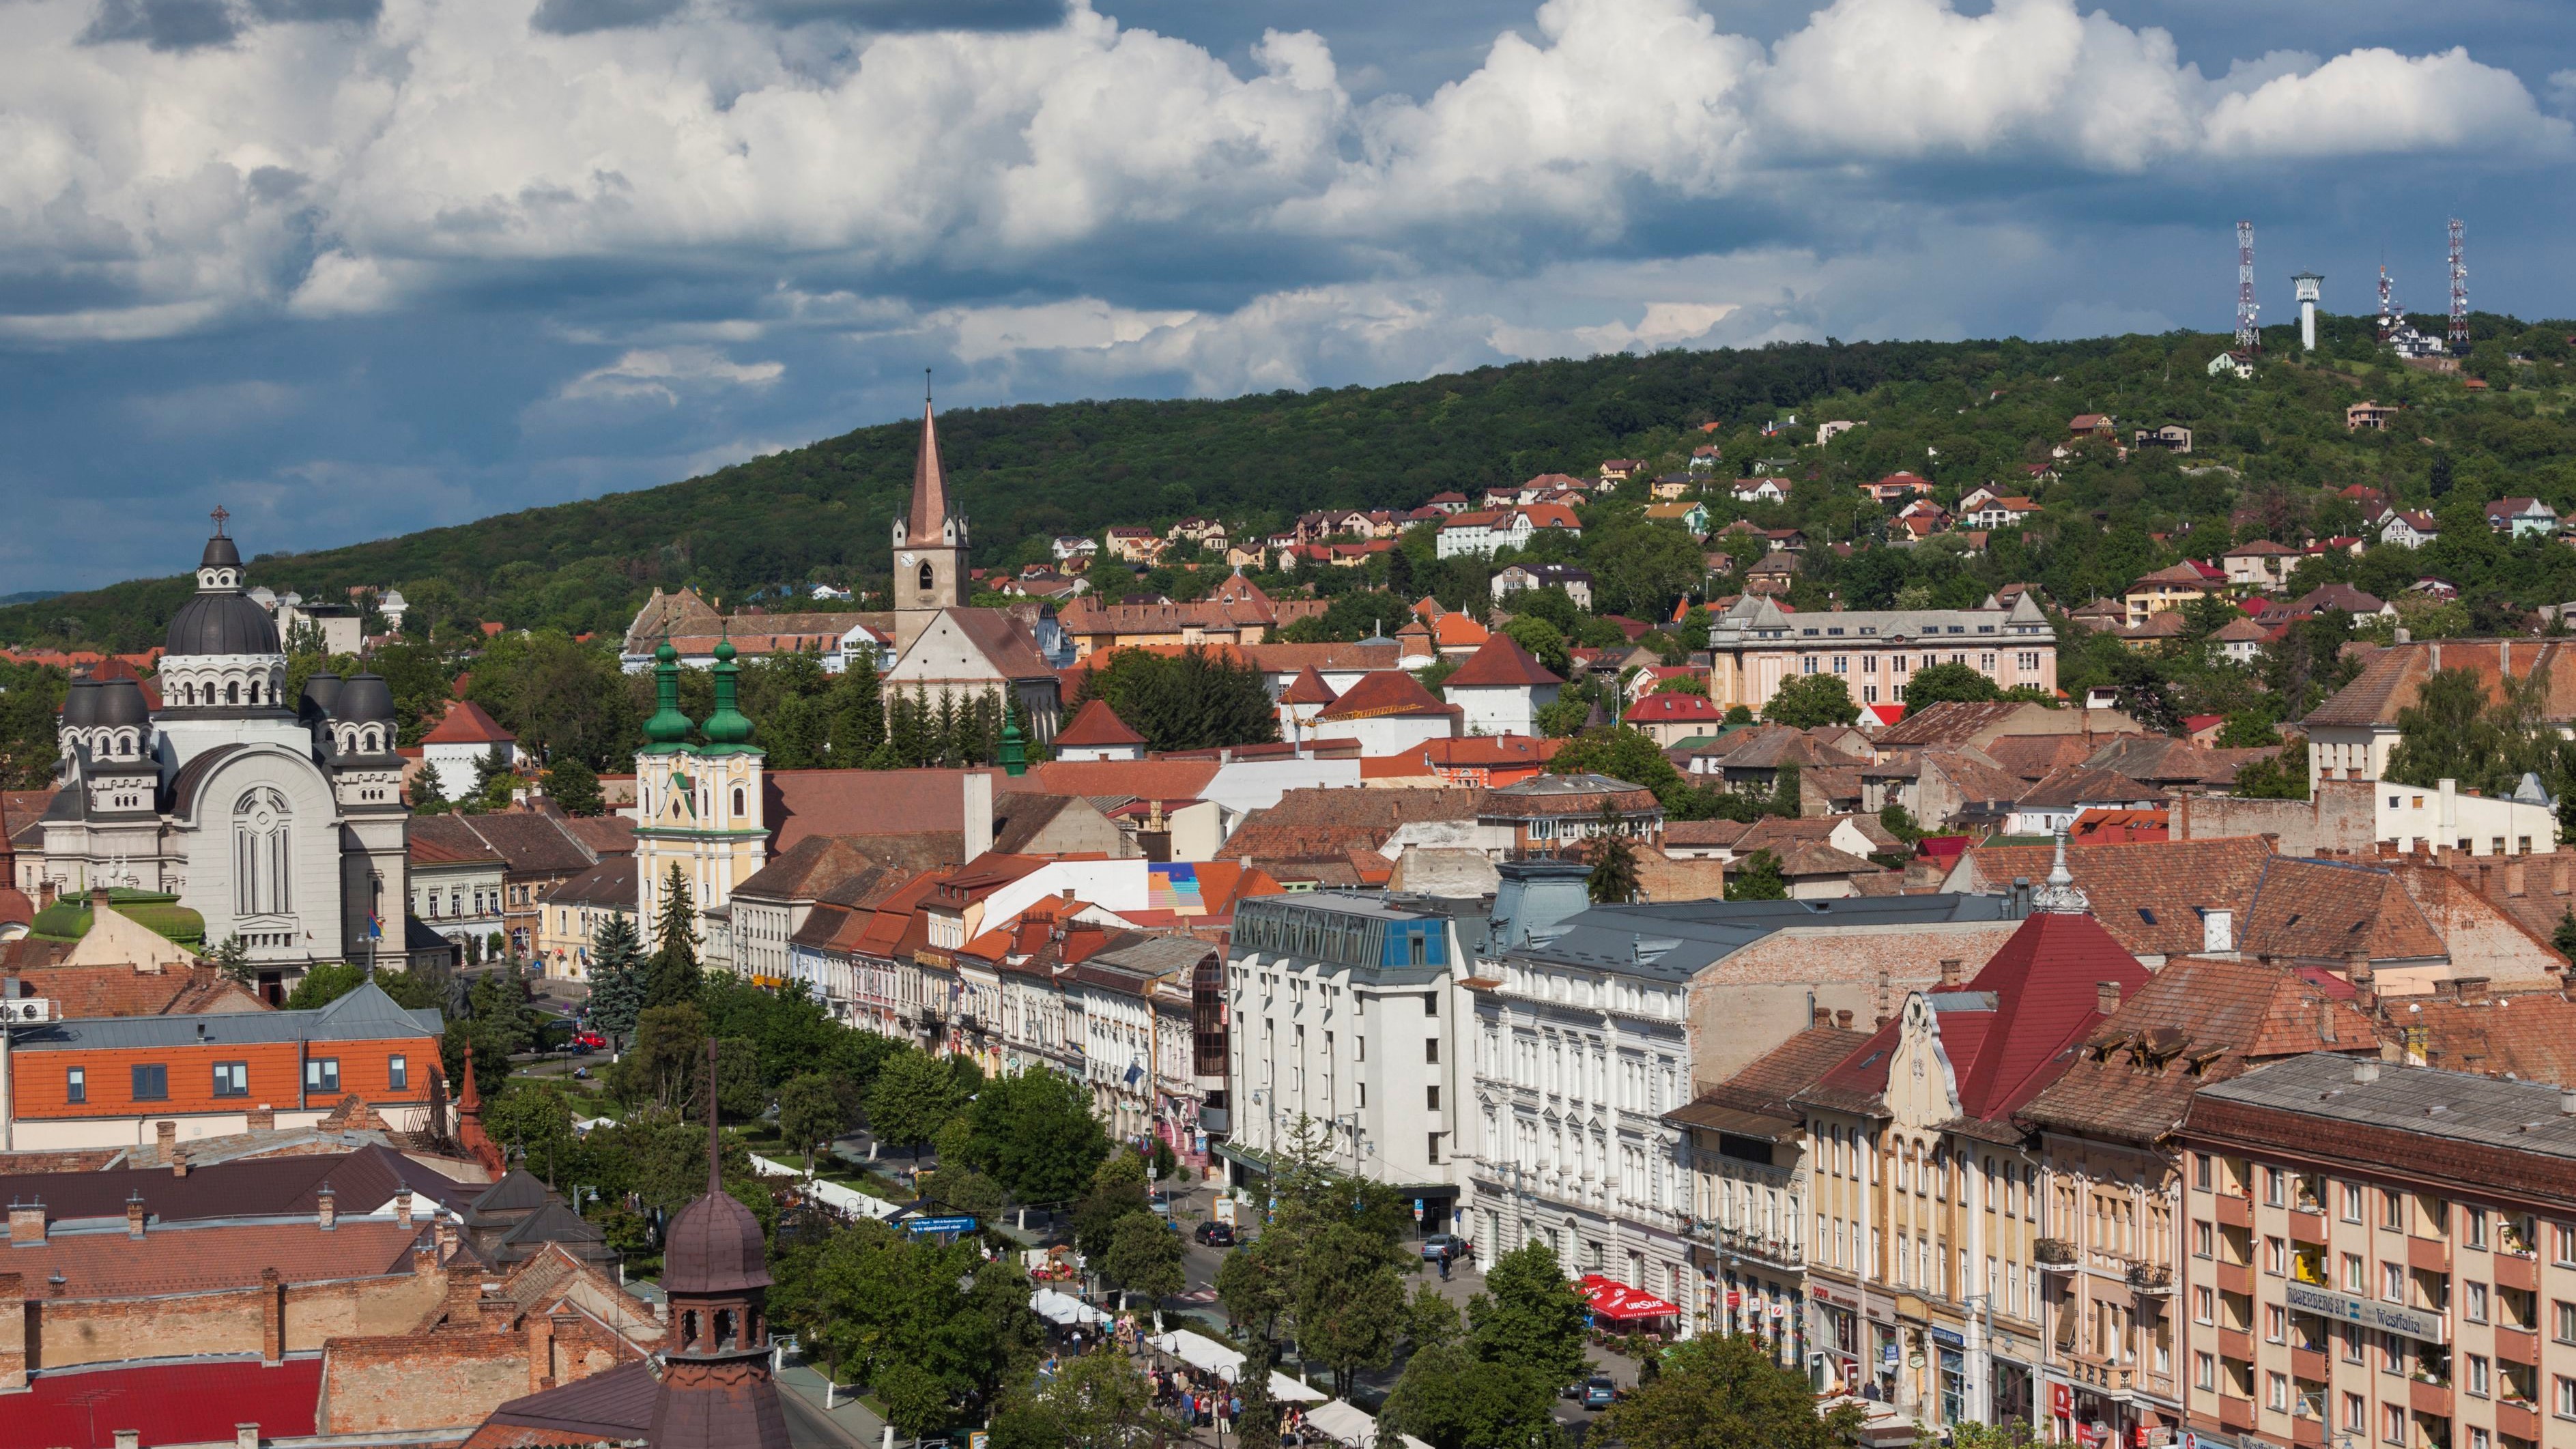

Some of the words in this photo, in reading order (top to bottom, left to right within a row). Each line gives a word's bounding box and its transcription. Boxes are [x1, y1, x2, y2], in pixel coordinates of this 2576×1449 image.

[1626, 1300, 1663, 1309] URSUS
[2287, 1287, 2333, 1312] ROSENBERG
[2376, 1308, 2420, 1334] Westfalia
